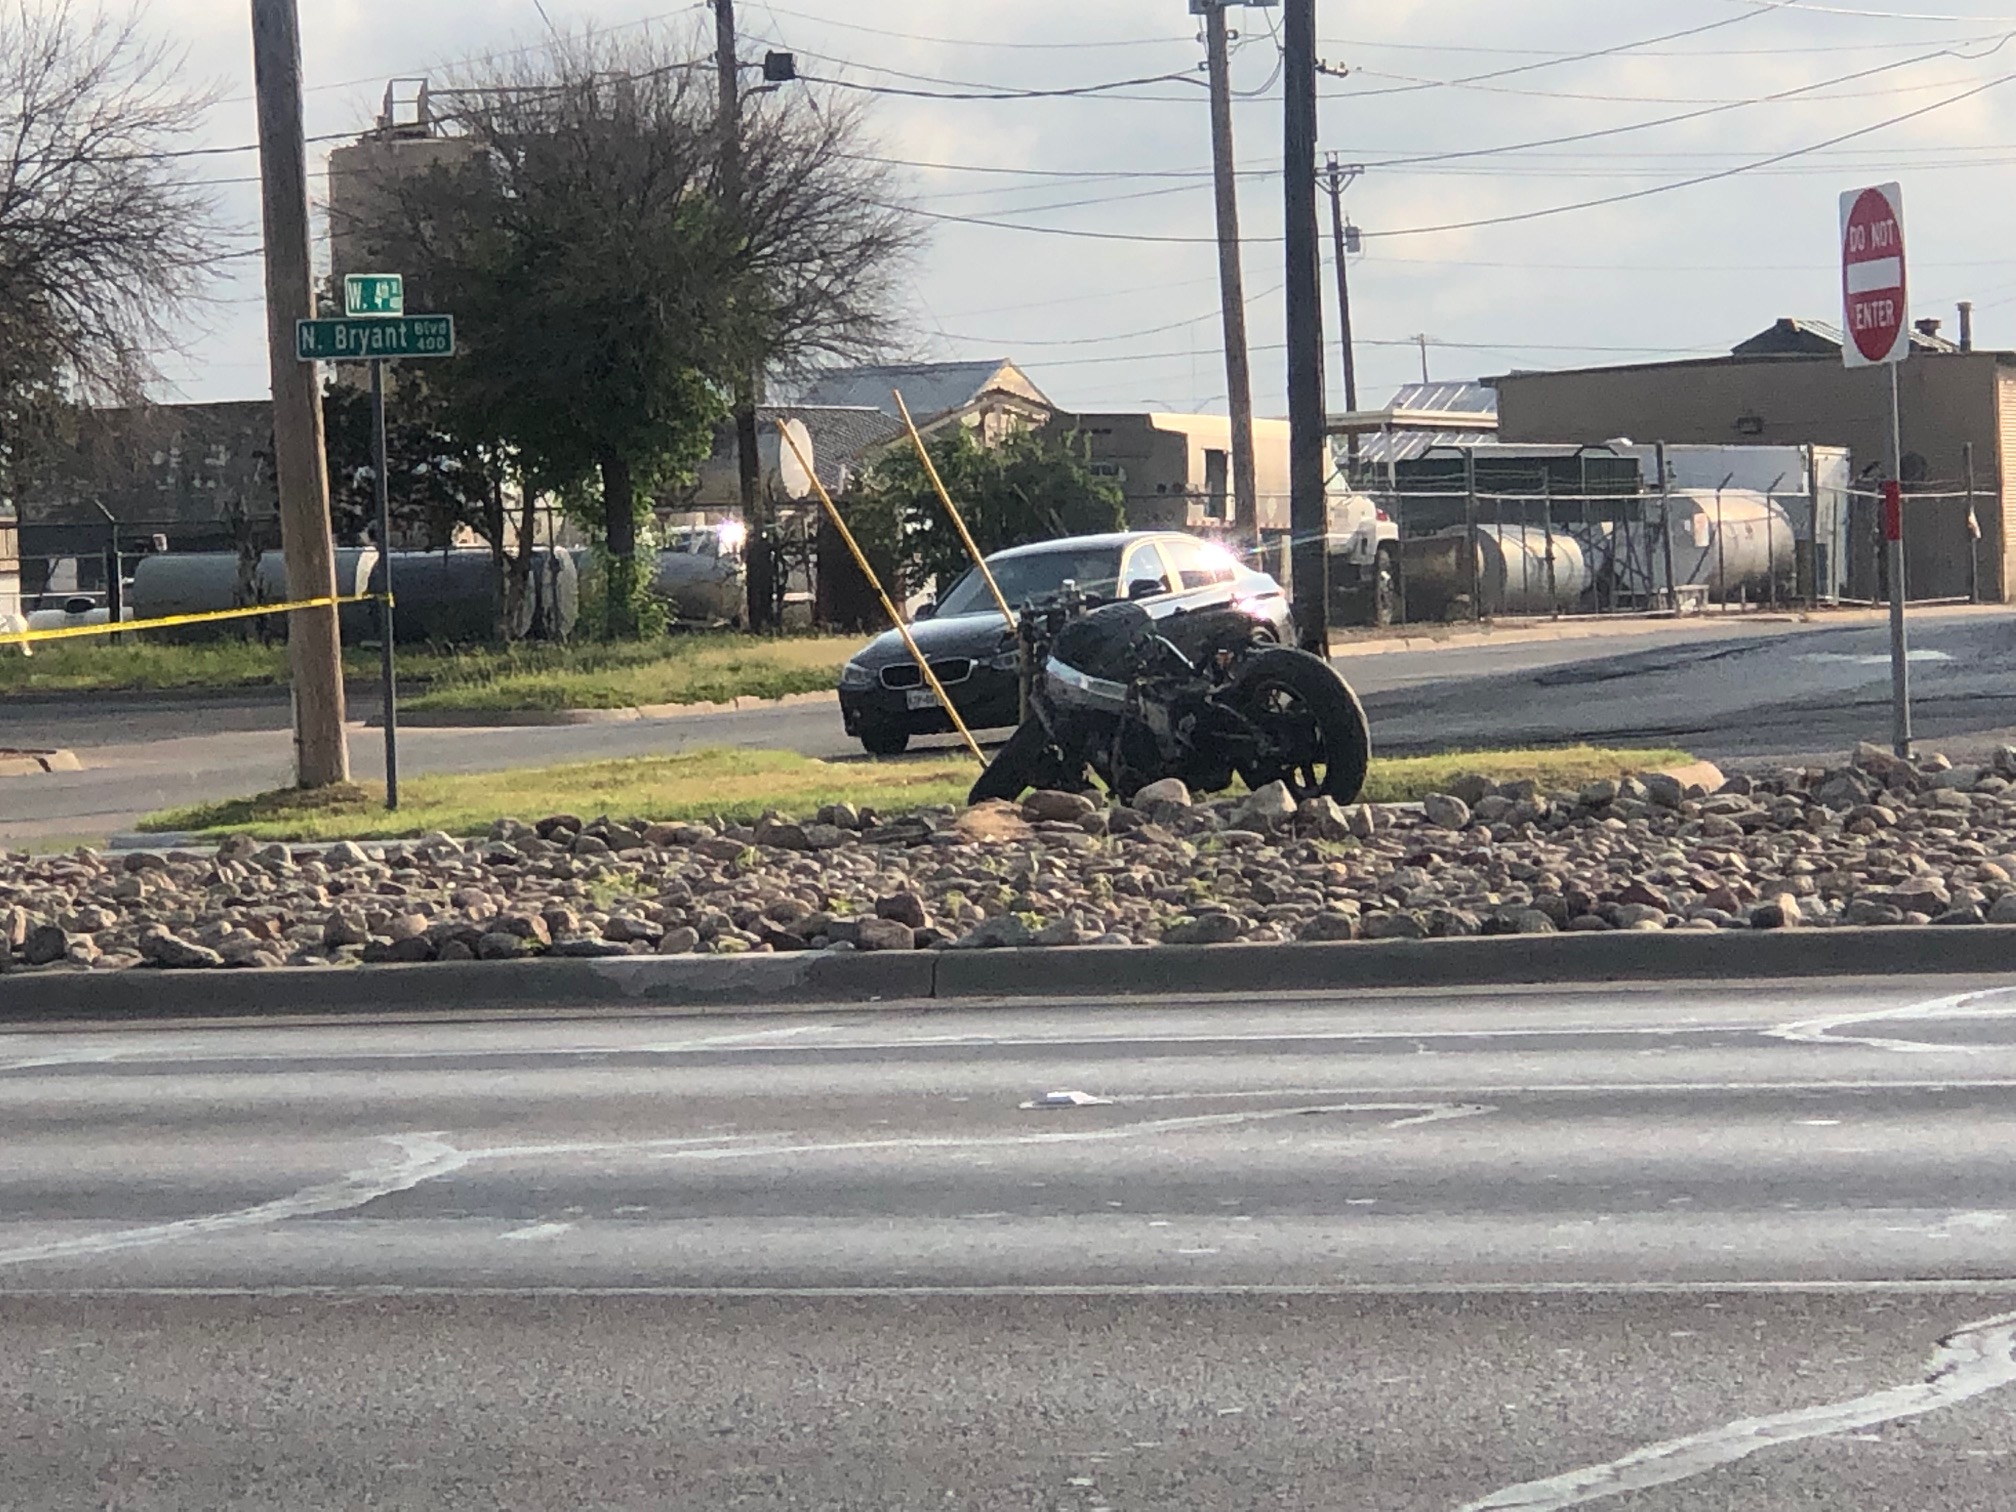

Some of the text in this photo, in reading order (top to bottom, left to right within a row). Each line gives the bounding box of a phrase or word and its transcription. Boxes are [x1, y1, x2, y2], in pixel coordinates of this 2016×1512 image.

[1850, 219, 1894, 252] DO NOT
[1855, 299, 1895, 330] ENTER
[302, 320, 446, 356] N. Bryant Blvd
[416, 336, 446, 350] 400
